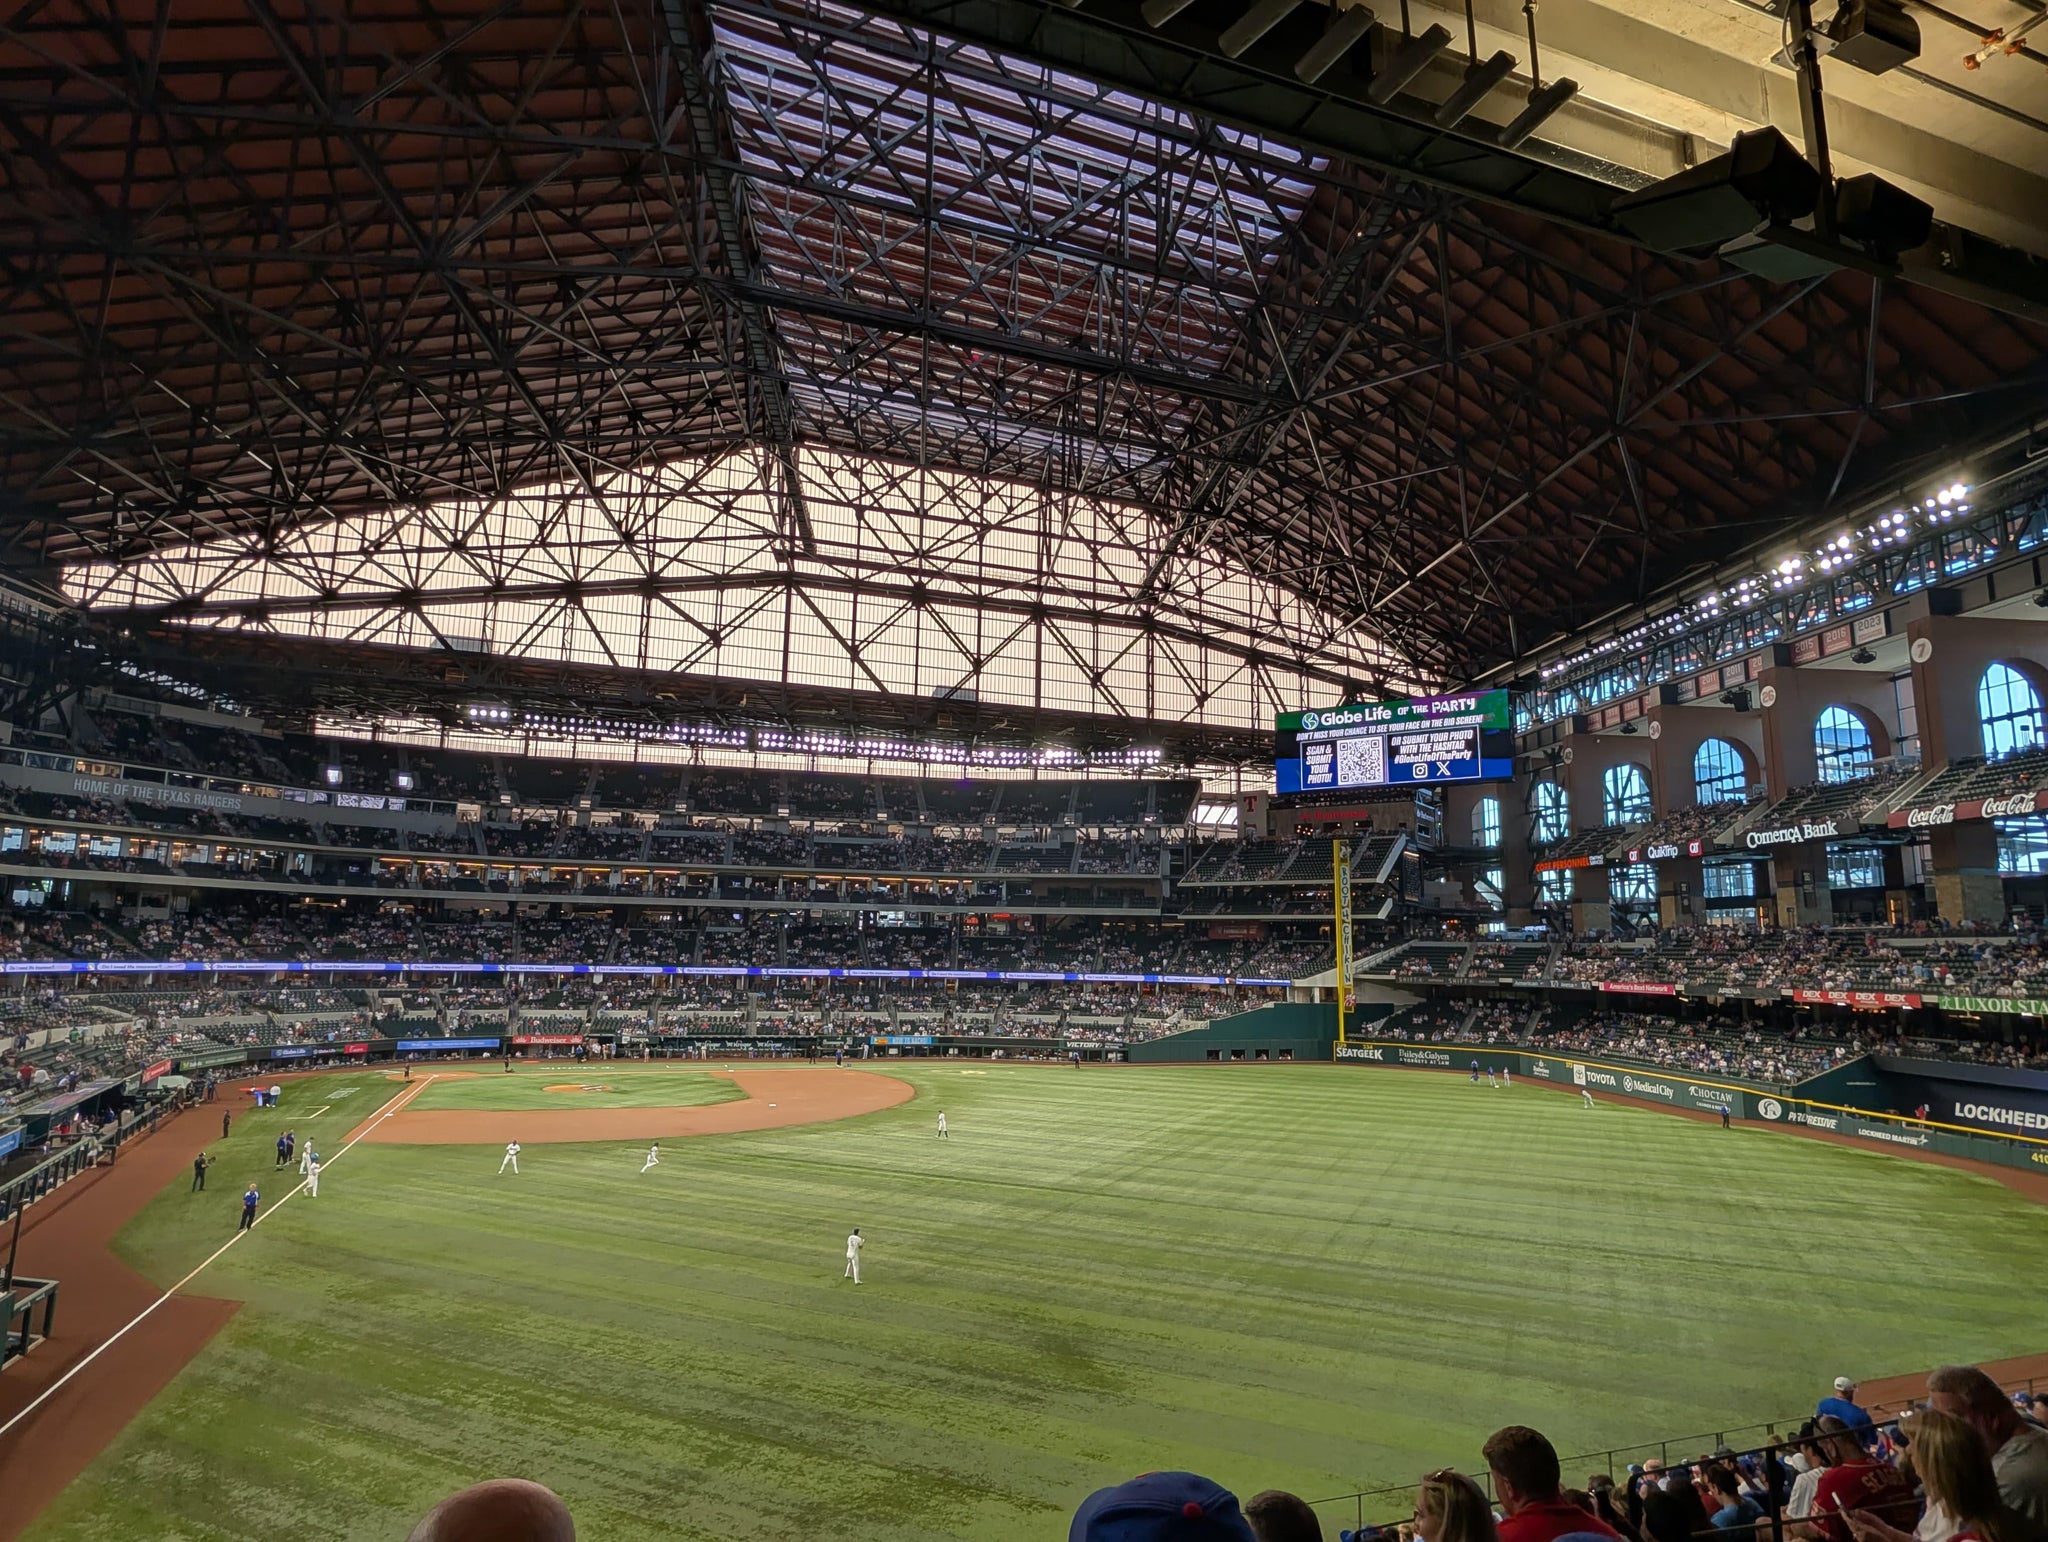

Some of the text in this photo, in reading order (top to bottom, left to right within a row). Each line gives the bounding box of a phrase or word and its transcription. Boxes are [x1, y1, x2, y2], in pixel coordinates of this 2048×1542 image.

[1858, 616, 1880, 631] 2023
[1795, 640, 1814, 652] 2015
[1917, 644, 1926, 658] 7
[1763, 690, 1774, 702] 26
[1321, 698, 1476, 726] Globe Life OF THE PARTY
[1296, 714, 1483, 741] DON'T MISS YOUR CHANCE TO SEE YOUR FACE ON THE BIG SCREEN!
[1650, 724, 1660, 735] 34
[1391, 730, 1473, 746] OR SUBMIT YOUR PHOTO
[1306, 744, 1332, 756] SCAN &
[1400, 740, 1465, 754] WITH THE HASHTAG
[1306, 754, 1333, 765] SUBMIT
[1310, 764, 1329, 774] YOUR
[1307, 772, 1333, 784] PHOTO!
[74, 778, 241, 809] HOME OF THE TEXAS RANGERS
[1803, 819, 1838, 840] Bank
[1648, 845, 1678, 858] QuikTrip
[1553, 856, 1589, 870] PERSONNEL
[1884, 994, 1906, 1002] DEX
[1954, 998, 2012, 1012] LUXOR
[1336, 1047, 1383, 1060] SEATGEEK
[1586, 1072, 1616, 1086] TOYOTA
[1633, 1081, 1674, 1099] Medical City
[1693, 1086, 1733, 1102] CHOCTAW
[1955, 1102, 2048, 1130] LOCKHEED
[1858, 1128, 1918, 1146] LOCKHEED MARTIN
